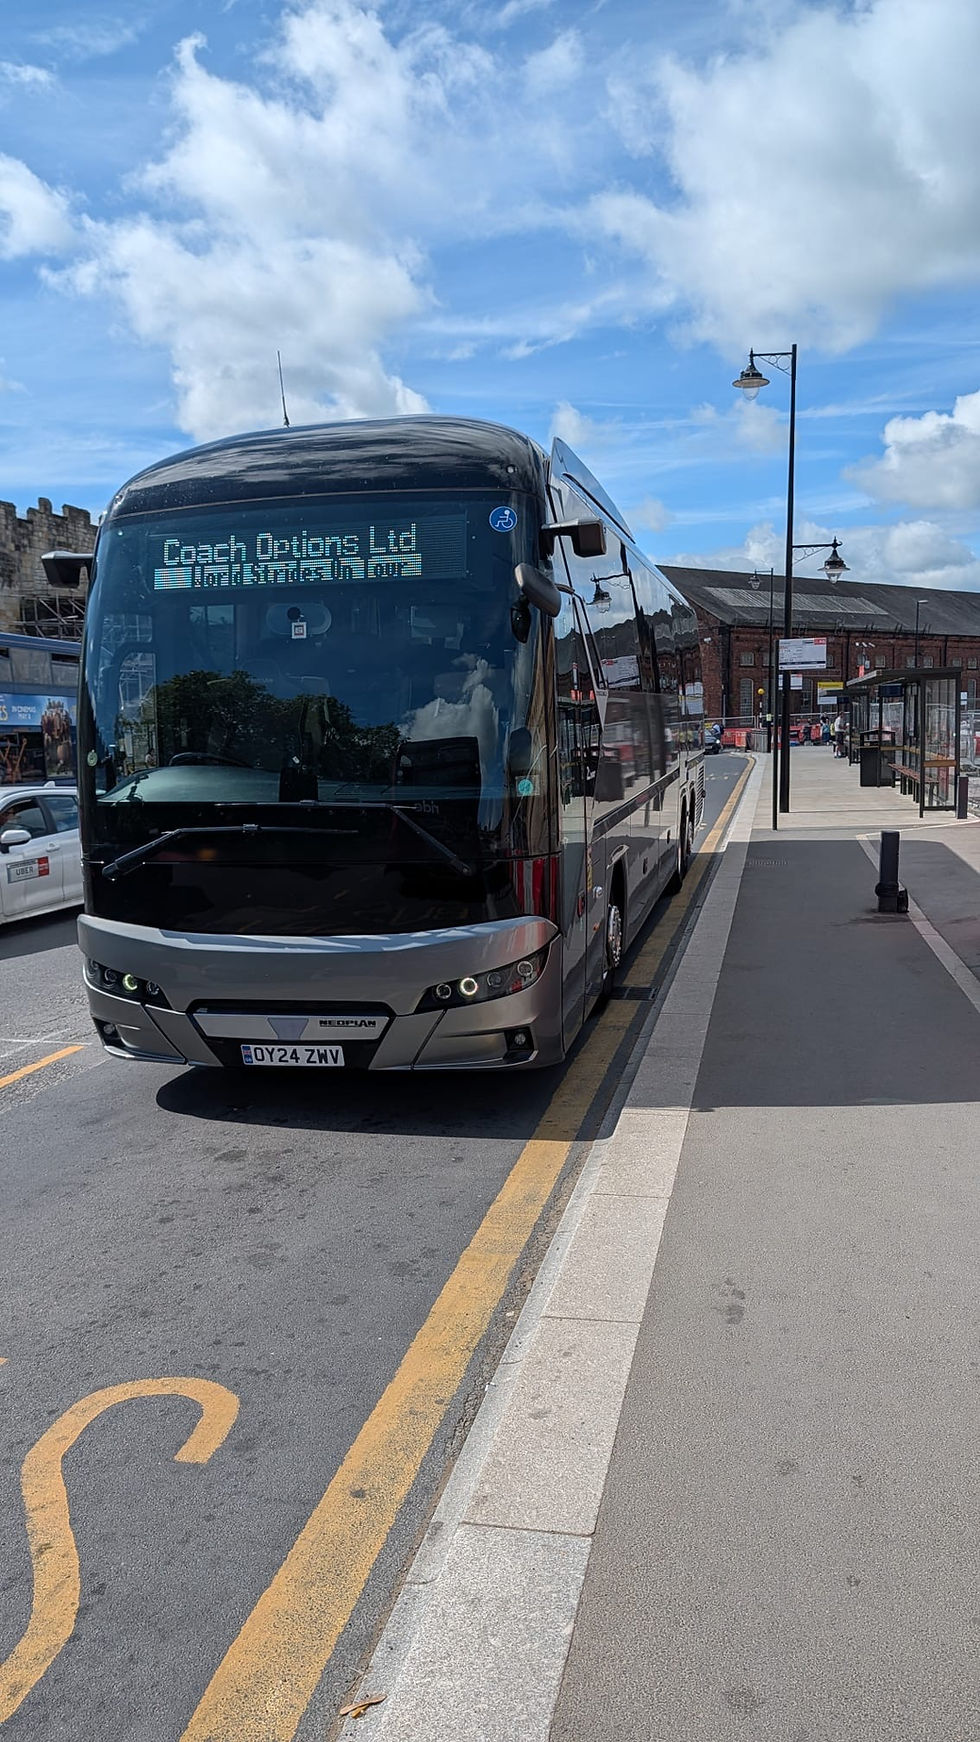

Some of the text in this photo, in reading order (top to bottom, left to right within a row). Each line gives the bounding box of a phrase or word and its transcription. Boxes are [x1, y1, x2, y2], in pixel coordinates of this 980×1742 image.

[163, 523, 416, 565] Coach Options Ltd
[15, 866, 34, 876] UBER
[319, 1019, 376, 1028] NEOPLAN
[254, 1047, 339, 1064] OY24 ZWV
